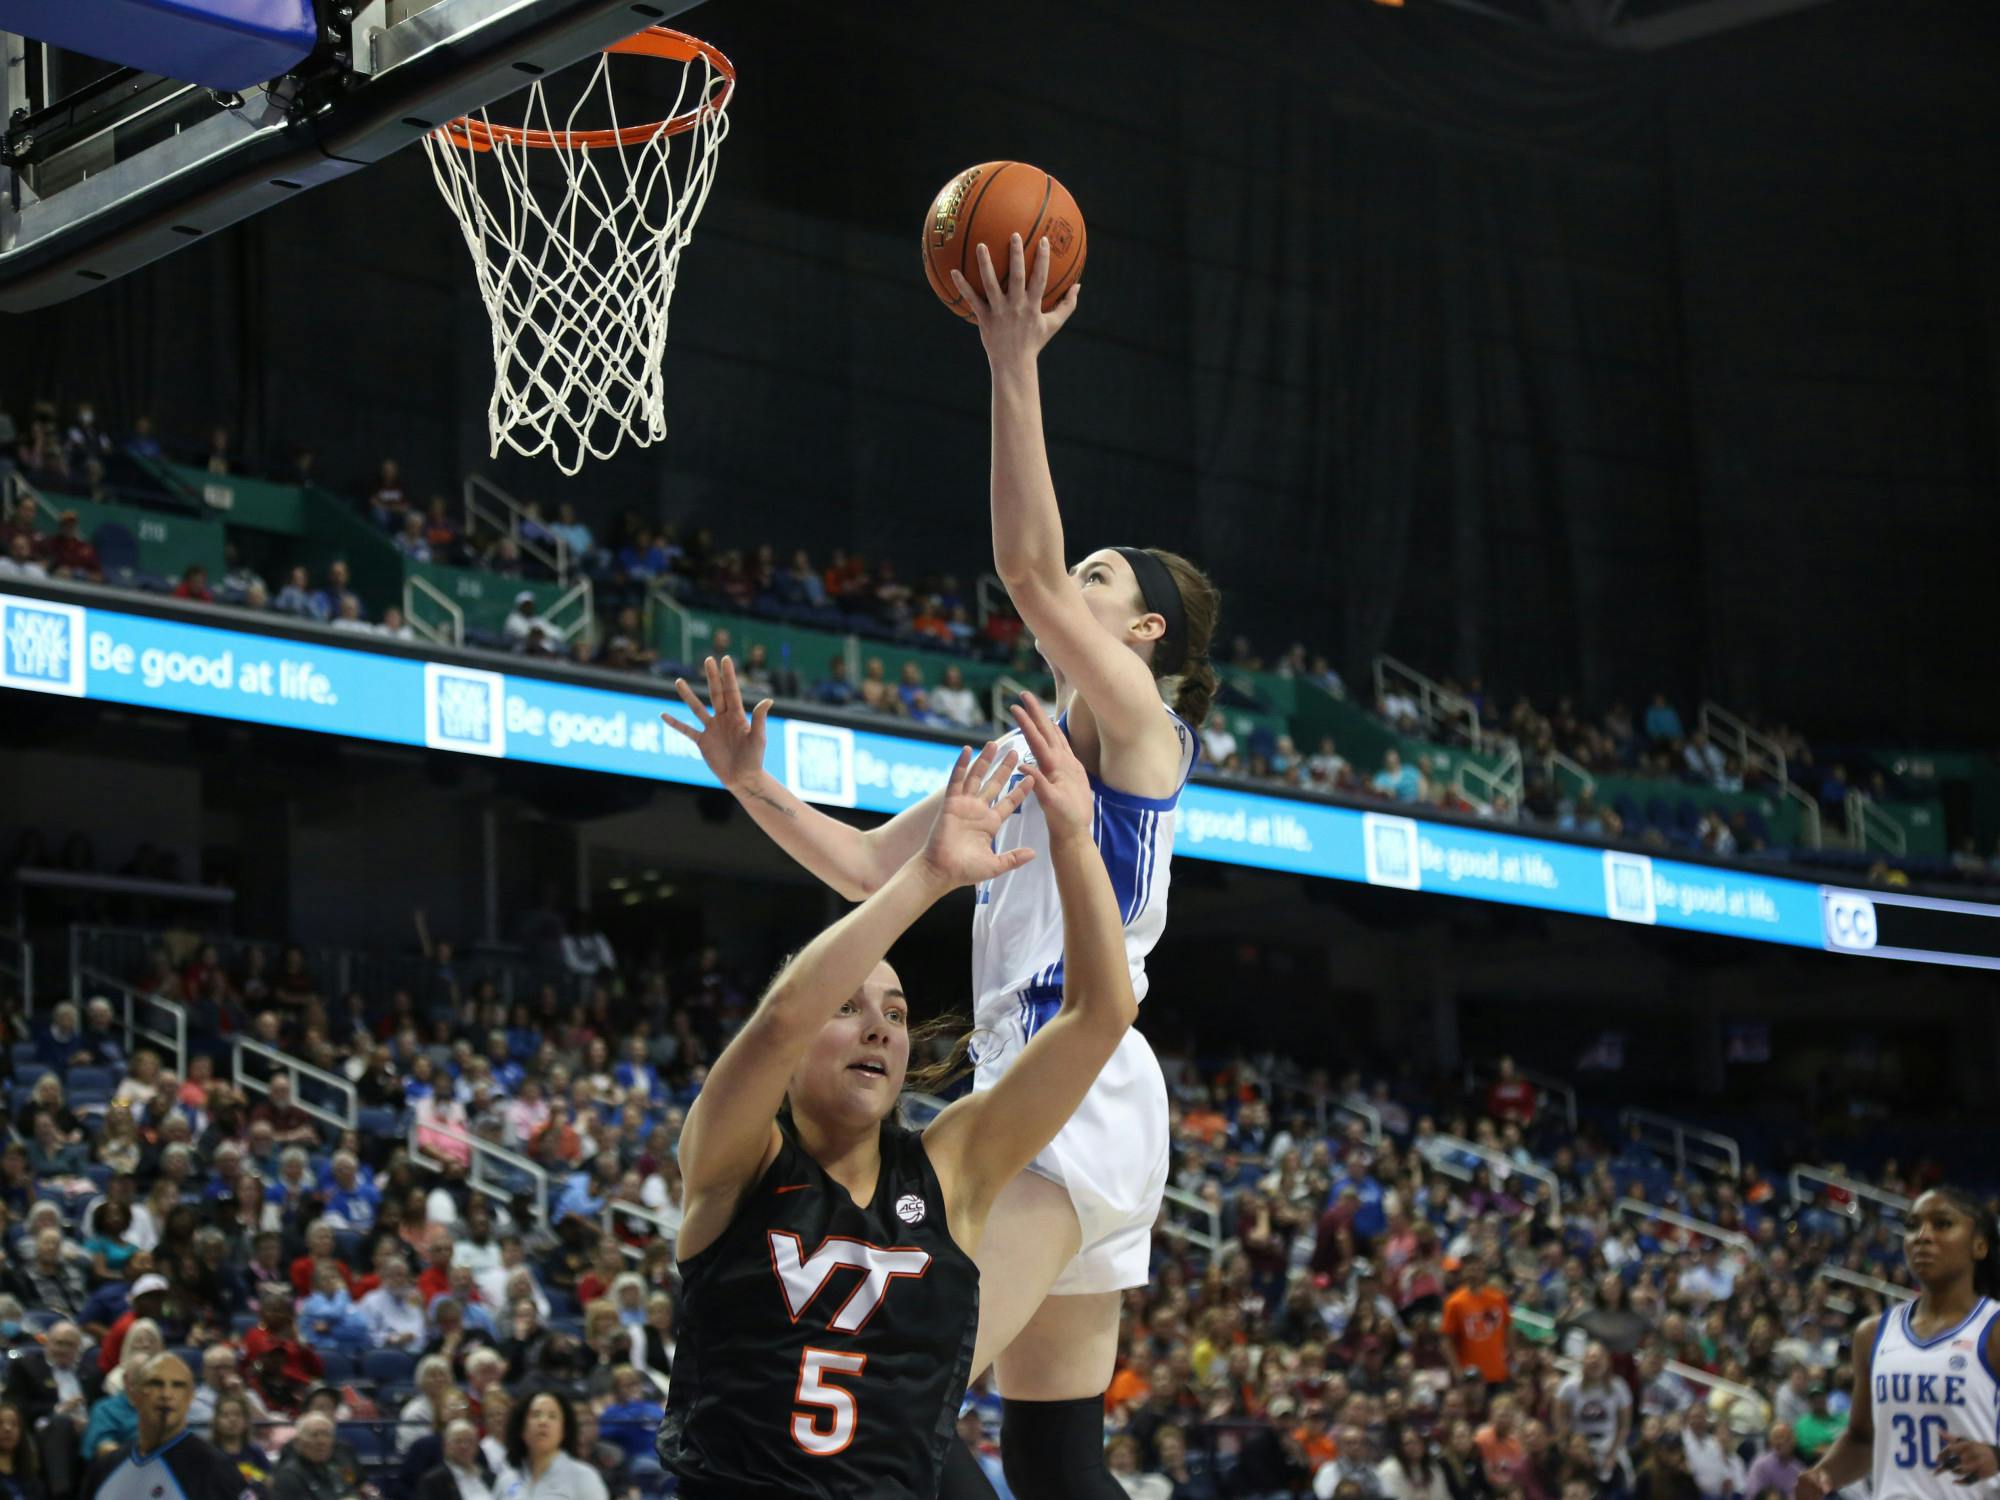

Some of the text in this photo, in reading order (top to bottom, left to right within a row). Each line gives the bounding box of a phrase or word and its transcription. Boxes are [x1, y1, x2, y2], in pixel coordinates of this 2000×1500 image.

[14, 651, 65, 679] LIFE
[89, 631, 339, 706] Be good at life.
[505, 695, 546, 737] Be
[549, 711, 627, 749] good
[630, 721, 660, 754] at
[899, 1201, 924, 1212] ACC
[768, 1229, 932, 1336] VT
[790, 1346, 867, 1456] 5
[1876, 1373, 1966, 1406] DUKE
[1892, 1413, 1949, 1469] 30
